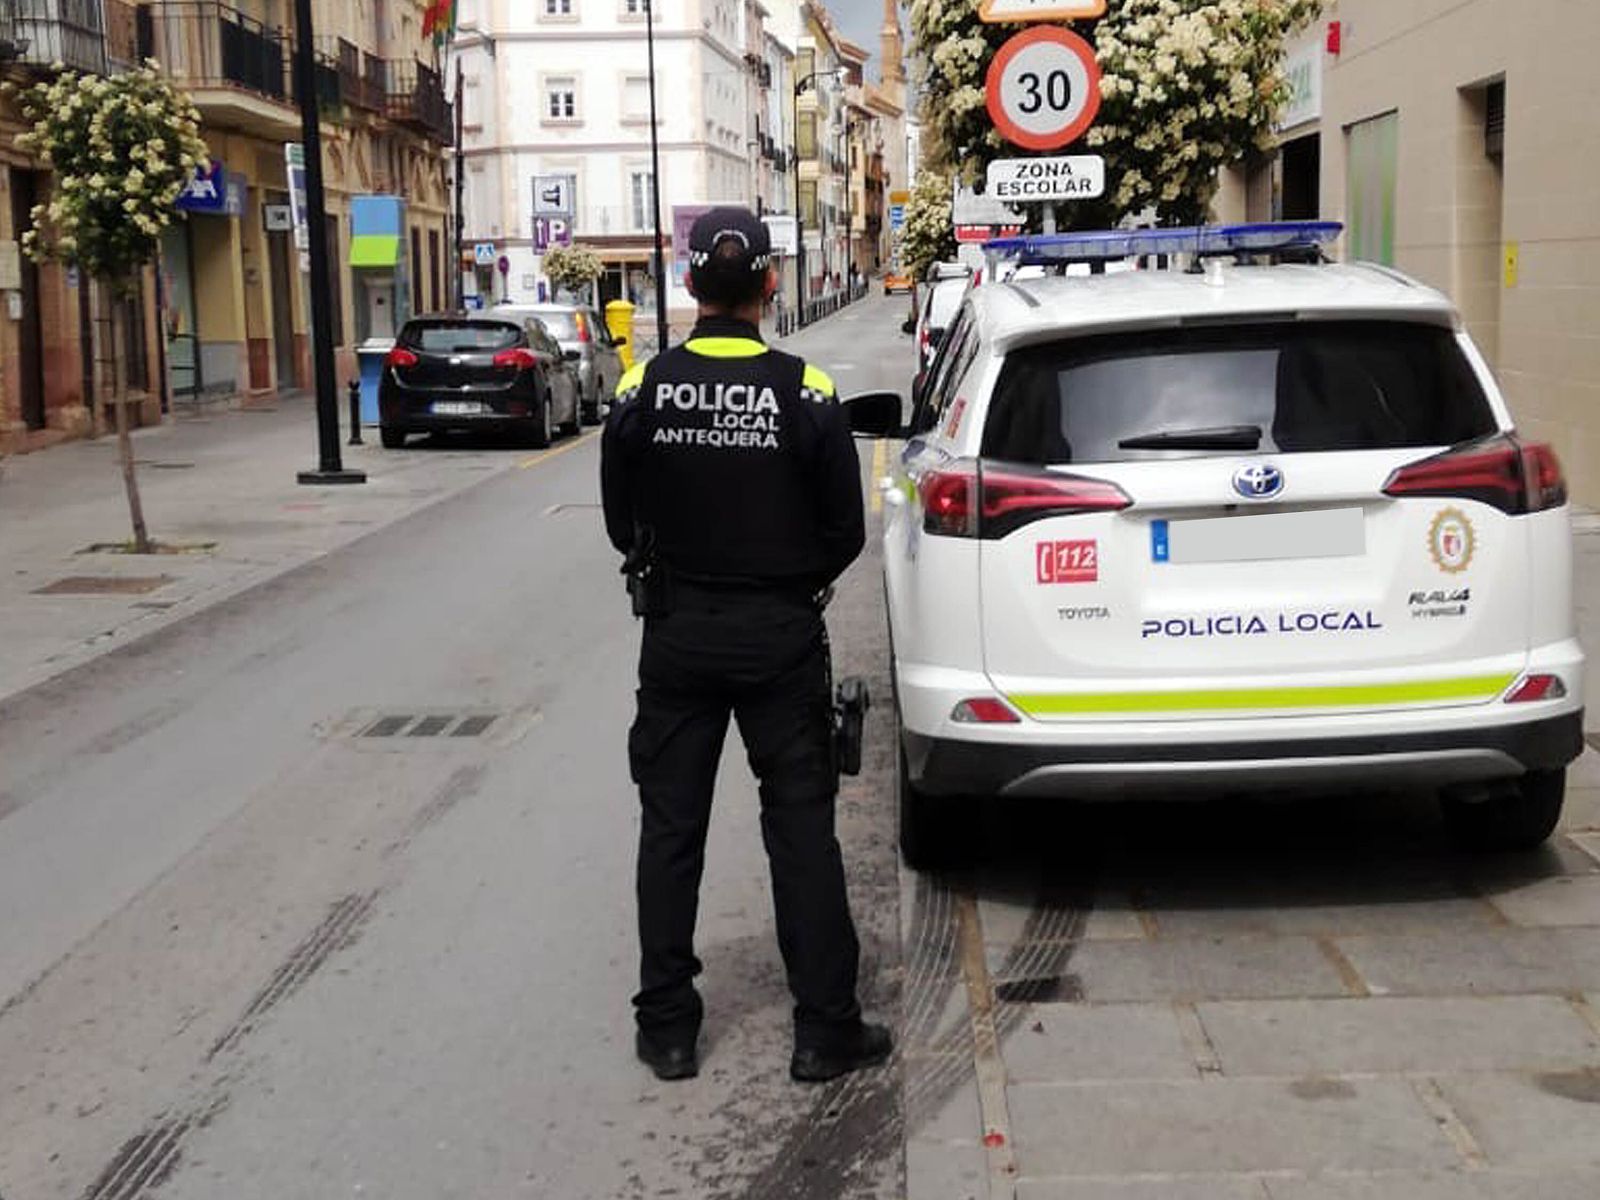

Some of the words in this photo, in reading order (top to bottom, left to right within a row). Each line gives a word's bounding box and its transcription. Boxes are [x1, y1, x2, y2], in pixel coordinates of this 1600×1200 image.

[1017, 70, 1072, 113] 30
[1016, 162, 1073, 179] ZONA
[997, 178, 1092, 196] ESCOLAR
[655, 383, 779, 414] POLICIA
[713, 412, 779, 431] LOCAL
[652, 428, 779, 448] ANTEQUERA
[1058, 546, 1095, 568] 112
[1057, 607, 1110, 619] TOYOTA
[1142, 615, 1267, 638] POLICIA
[1279, 611, 1382, 632] LOCAL
